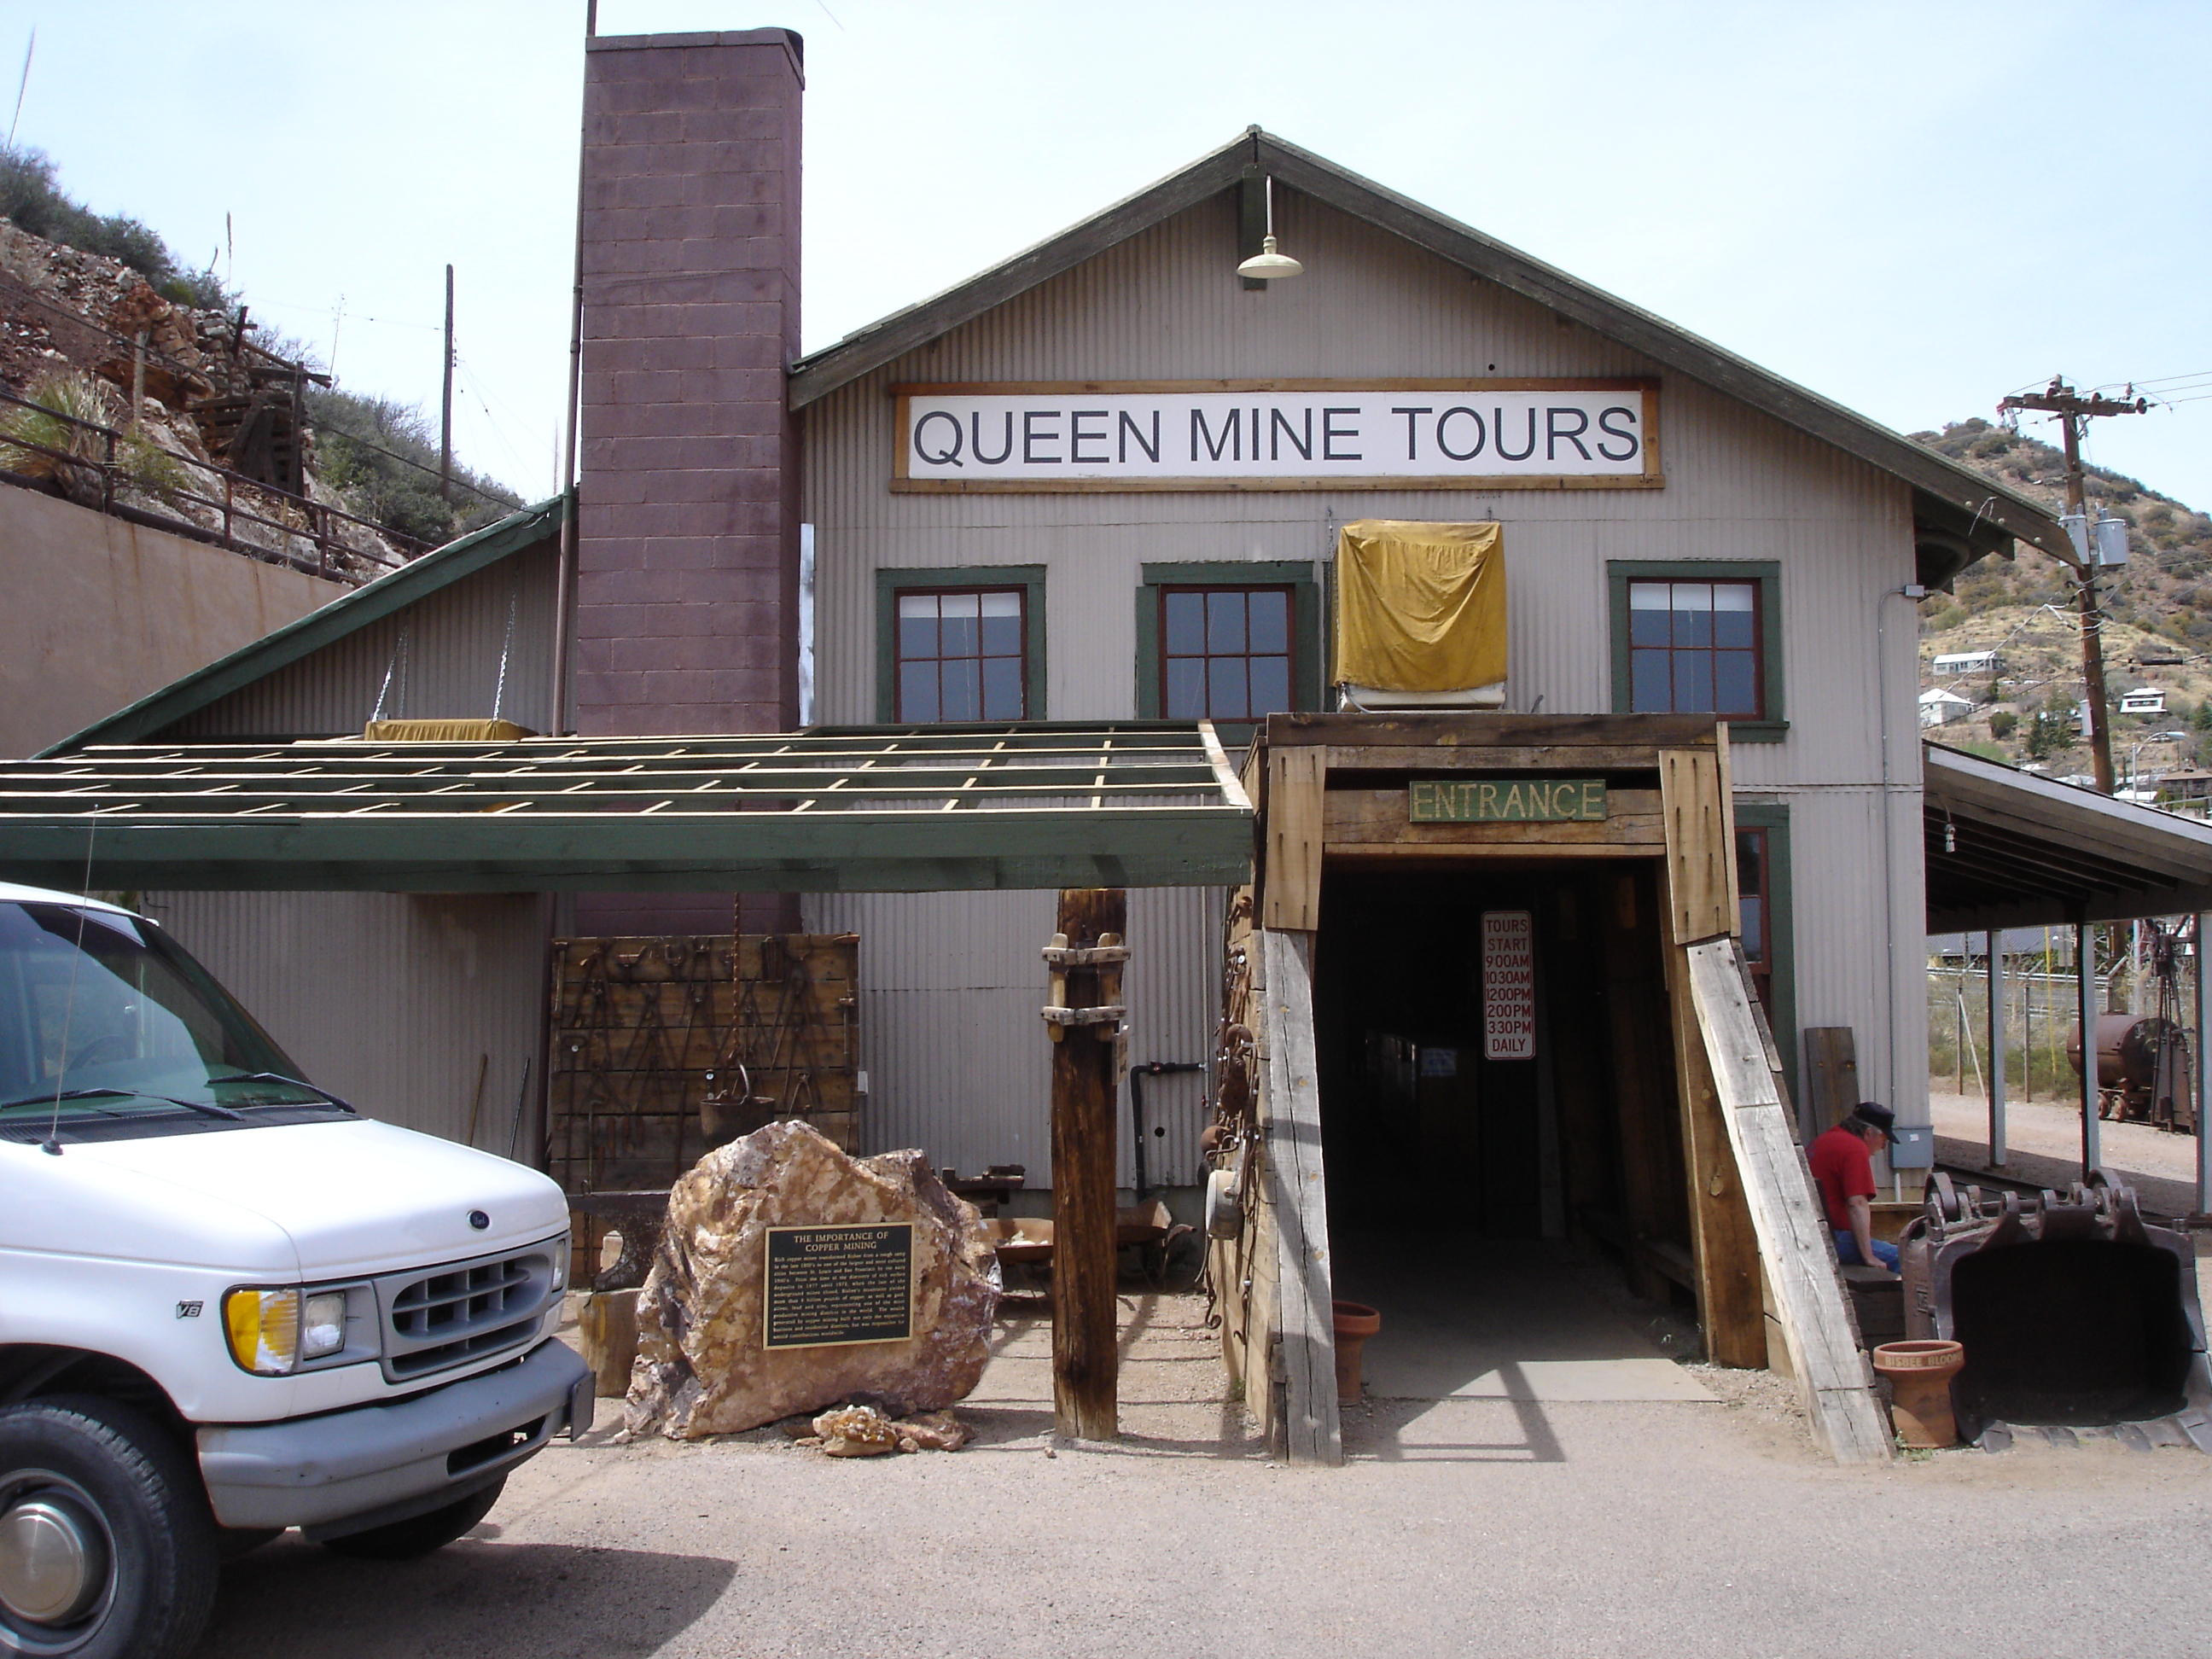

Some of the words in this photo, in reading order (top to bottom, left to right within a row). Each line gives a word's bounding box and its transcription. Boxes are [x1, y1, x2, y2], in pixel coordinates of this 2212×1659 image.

[911, 403, 1159, 467] QUEEN
[1191, 408, 1362, 461] MINE
[1392, 406, 1639, 461] TOURS
[1412, 783, 1603, 818] ENTRANCE
[1487, 919, 1528, 932] TOURS
[1487, 938, 1527, 952] START
[1493, 1039, 1525, 1051] DAILY
[815, 1231, 873, 1242] IMPORTANCE
[805, 1243, 840, 1251] COPPER
[843, 1241, 877, 1249] MINING
[177, 1305, 201, 1318] V8
[1885, 1357, 1923, 1367] BISBEE
